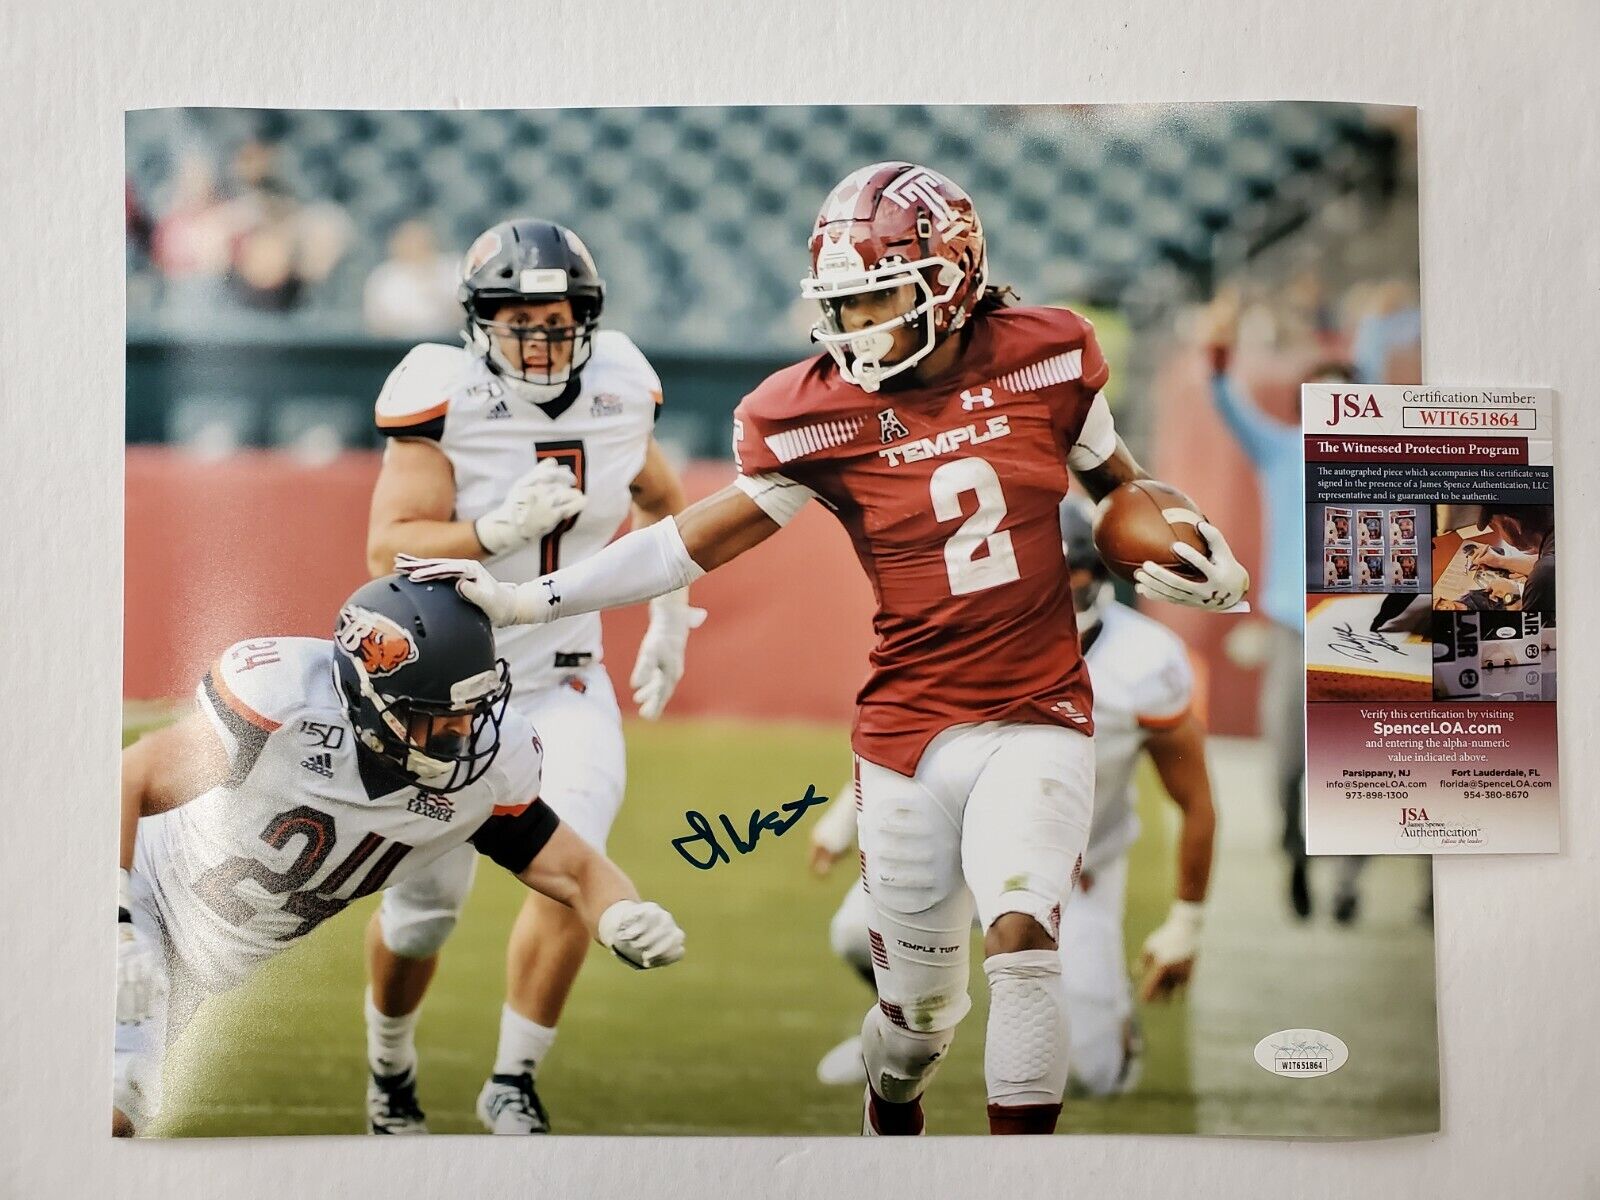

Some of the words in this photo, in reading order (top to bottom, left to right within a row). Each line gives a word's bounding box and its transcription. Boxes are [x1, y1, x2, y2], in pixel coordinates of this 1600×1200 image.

[1402, 390, 1478, 403] Certification
[1482, 392, 1536, 404] Number:
[1326, 393, 1383, 426] JSA
[1420, 410, 1519, 426] WIT651864
[879, 415, 1011, 467] TEMPLE
[1317, 441, 1339, 453] The
[1342, 442, 1401, 453] Witnessed
[1405, 443, 1465, 455] Protection
[1469, 444, 1519, 457] Program
[1317, 467, 1332, 475] The
[1334, 468, 1381, 477] autographed
[1384, 468, 1403, 478] piece
[1404, 468, 1428, 477] which
[1430, 469, 1478, 478] accompanies
[1480, 469, 1494, 477] this
[1497, 469, 1533, 478] certificate
[1318, 479, 1342, 489] signed
[1345, 479, 1353, 487] in
[1354, 479, 1367, 487] the
[1369, 481, 1401, 489] presence
[1443, 481, 1470, 490] Spence
[1472, 481, 1530, 490] Authentication,
[1318, 492, 1371, 501] representative
[1397, 493, 1439, 501] guaranteed
[929, 456, 1020, 596] 2
[1360, 709, 1388, 721] Verify
[1391, 709, 1408, 719] this
[1410, 709, 1464, 719] certification
[1467, 709, 1478, 721] by
[1481, 709, 1514, 721] visiting
[1373, 721, 1501, 736] SpenceLOA.com
[1365, 738, 1383, 748] and
[1385, 738, 1423, 750] entering
[1426, 738, 1440, 748] the
[1443, 738, 1510, 750] alpha-numeric
[1388, 752, 1412, 762] value
[1414, 752, 1456, 761] indicated
[1459, 752, 1488, 761] above.
[1342, 769, 1396, 778] Parsippany,
[1398, 769, 1410, 777] NJ
[1451, 769, 1470, 777] Fort
[1473, 769, 1526, 778] Lauderdale,
[1528, 769, 1540, 777] FL
[1326, 780, 1427, 789] info@SpenceLOA.com
[1440, 780, 1552, 789] florida@SpenceLOA.com
[1345, 791, 1408, 799] 973-898-1300
[1463, 791, 1529, 799] 954-380-8670
[1399, 807, 1429, 825] JSA
[897, 939, 936, 953] TEMPLE
[939, 945, 960, 953] TUFF
[1282, 1061, 1323, 1069] WIT651864
